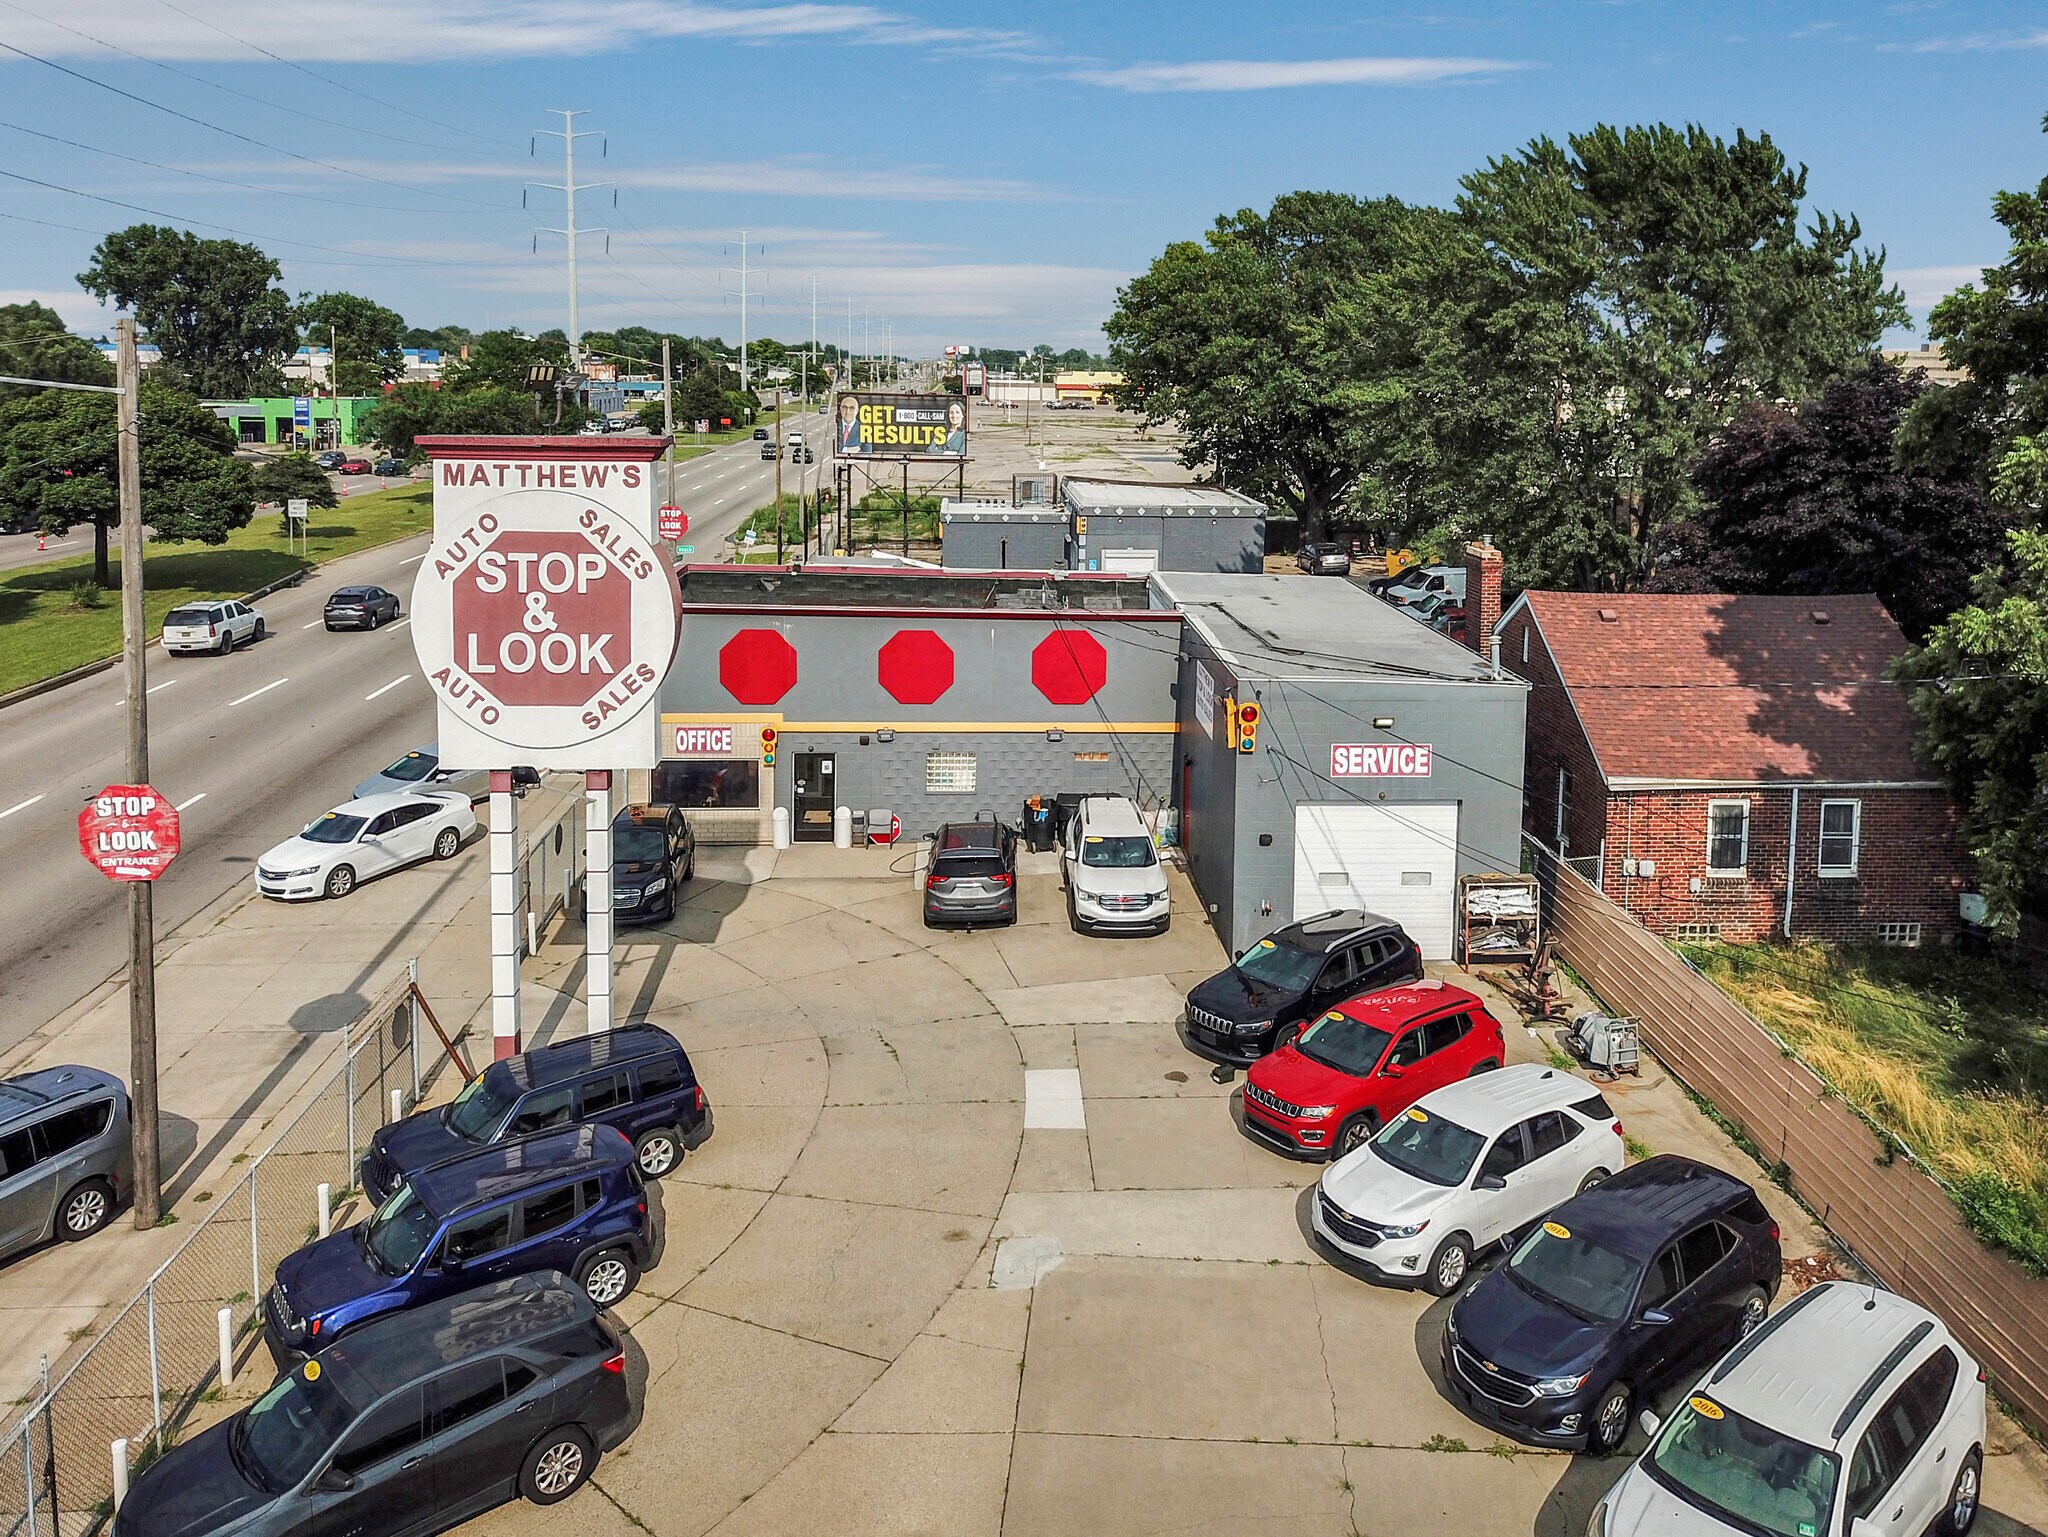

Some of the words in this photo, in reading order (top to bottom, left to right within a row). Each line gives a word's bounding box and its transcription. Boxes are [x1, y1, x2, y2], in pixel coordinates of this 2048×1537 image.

[859, 404, 895, 424] GET
[859, 425, 947, 445] RESULTS
[443, 463, 641, 488] MATTHEW'S
[660, 521, 681, 529] LOOK
[434, 513, 499, 580] AUTO
[579, 508, 653, 580] SALES
[475, 550, 607, 594] STOP
[522, 591, 558, 634] &
[467, 632, 615, 674] LOOK
[431, 667, 500, 725] AUTO
[581, 663, 656, 730] SALES
[676, 730, 731, 751] OFFICE
[1334, 747, 1429, 774] SERVICE
[97, 796, 156, 817] STOP
[121, 819, 130, 828] &
[99, 831, 158, 852] LOOK
[101, 857, 160, 867] ENTRANCE
[1547, 1224, 1567, 1236] 2018
[1694, 1400, 1719, 1416] 2016
